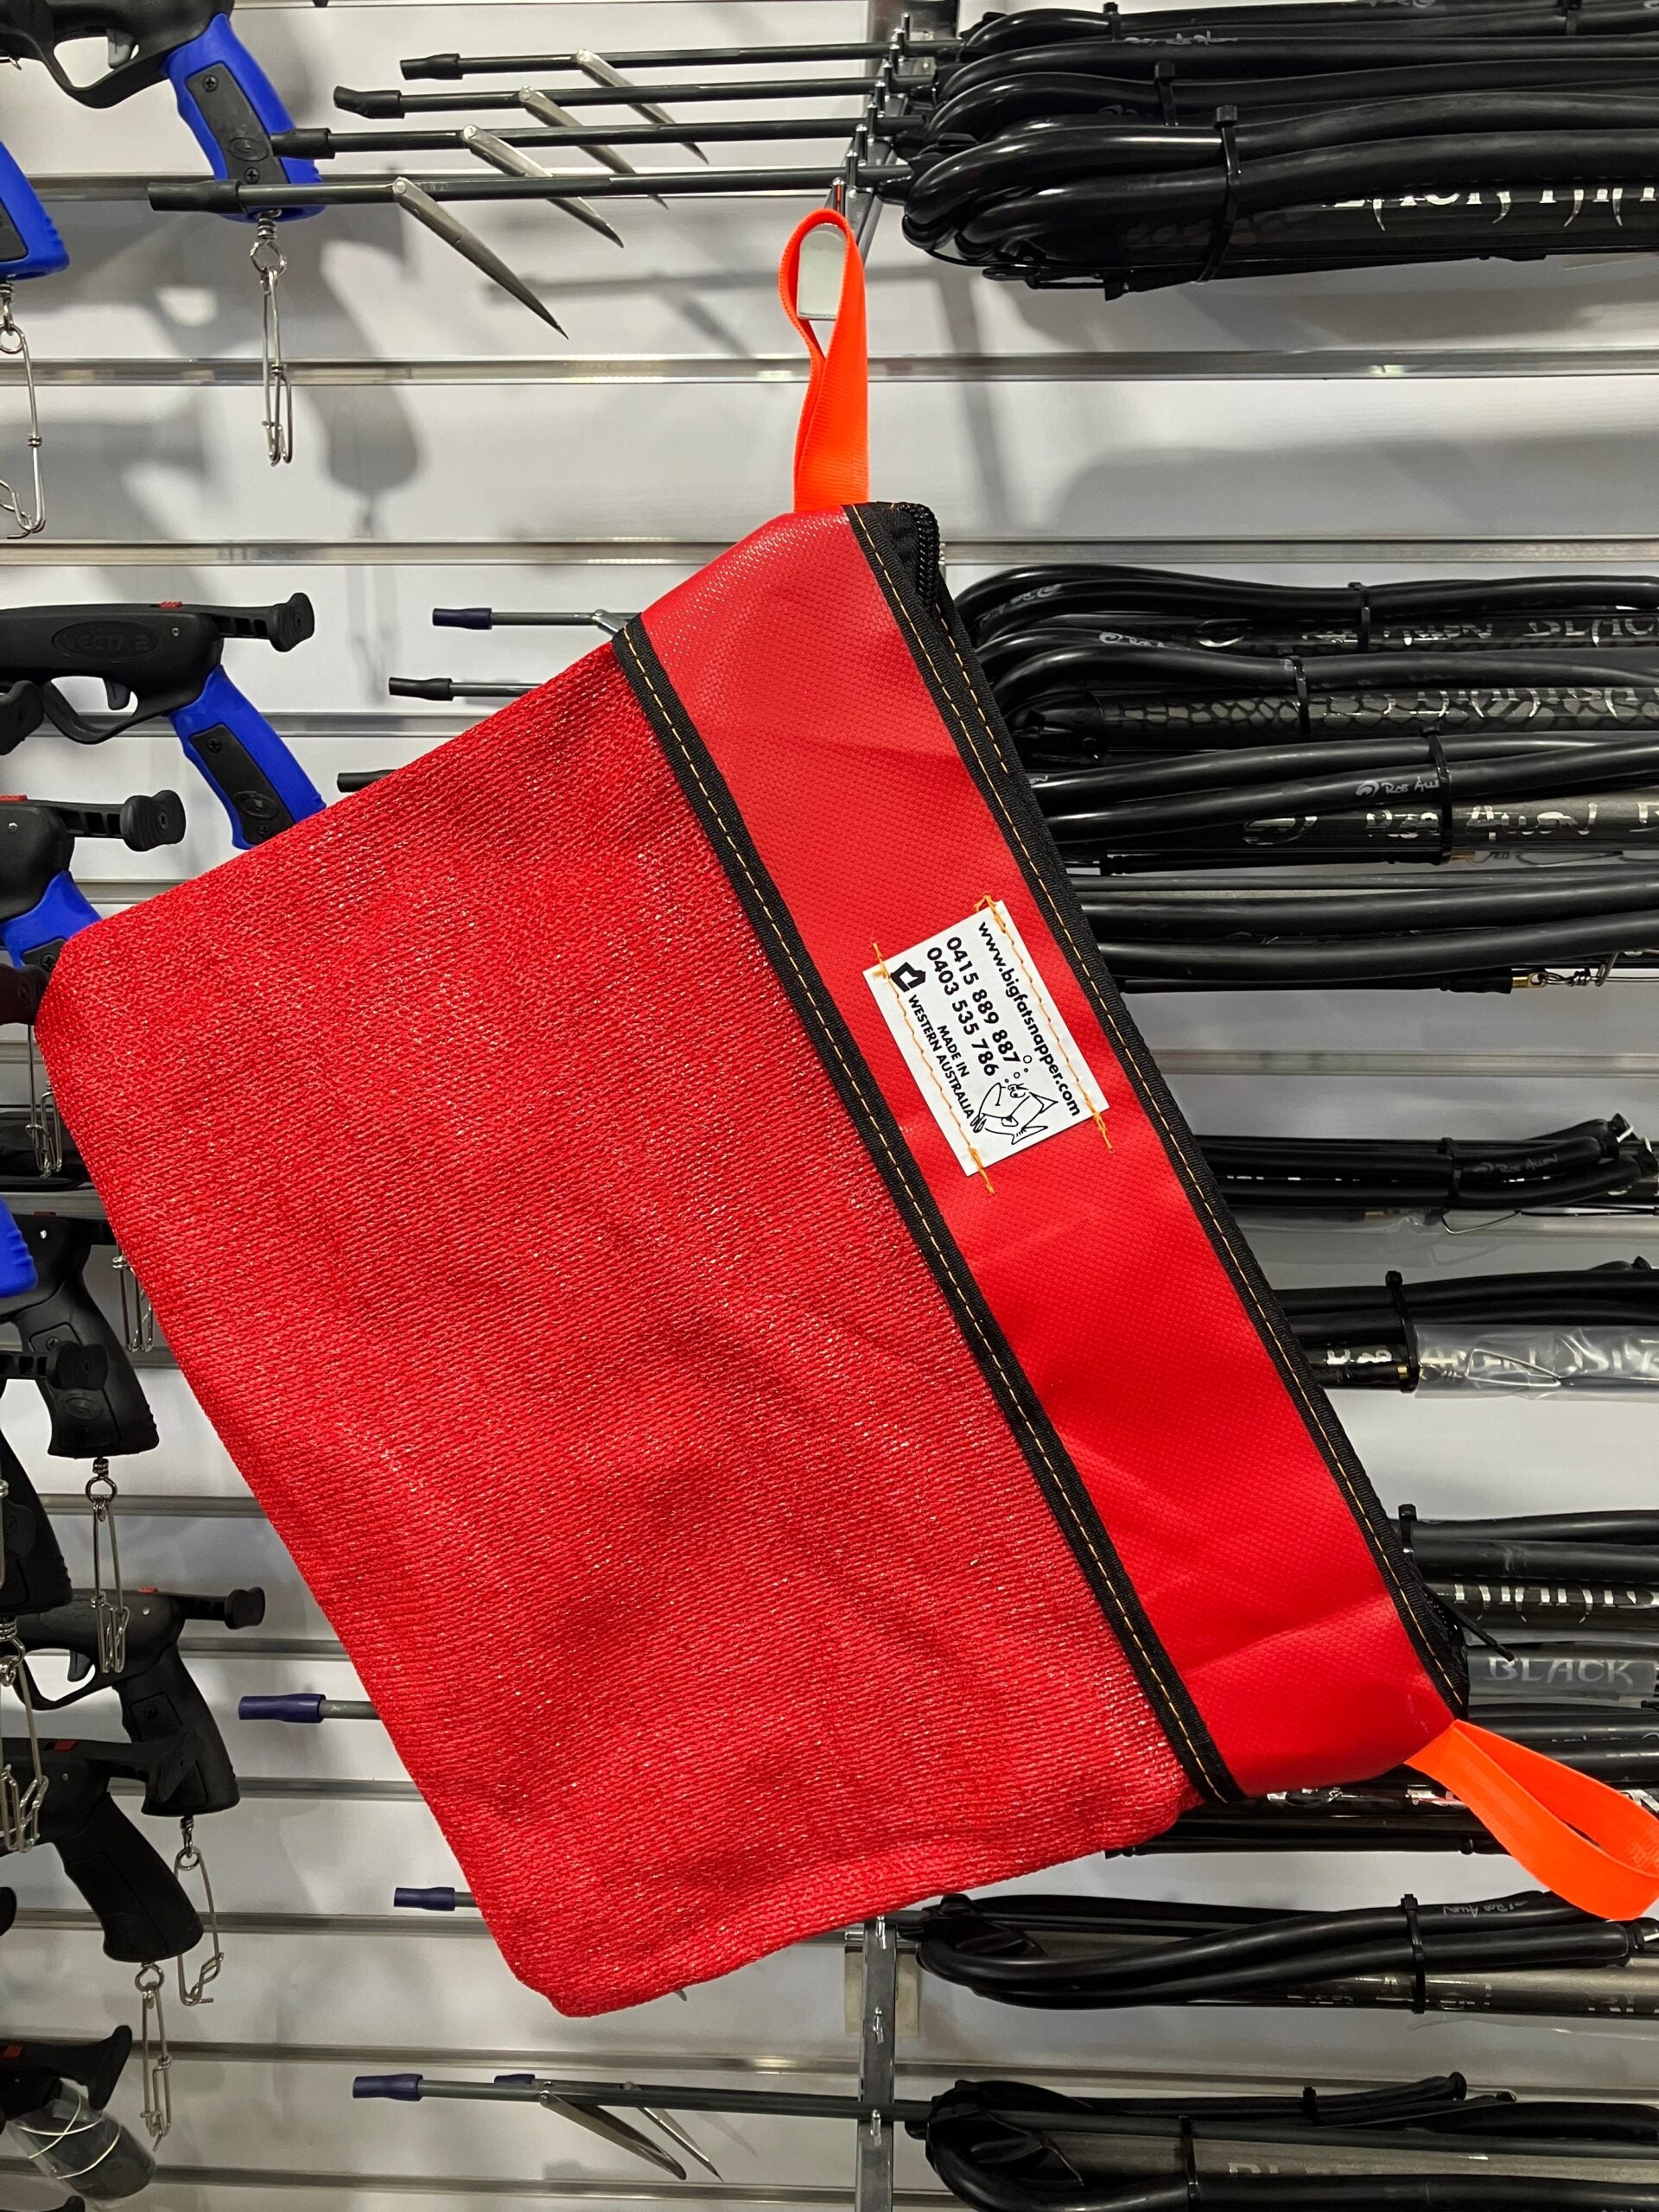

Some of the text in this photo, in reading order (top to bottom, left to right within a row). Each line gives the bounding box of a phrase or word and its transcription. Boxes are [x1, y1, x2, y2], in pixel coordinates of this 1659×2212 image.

[909, 995, 976, 1119] WESTERN AUSTRALIA
[927, 947, 999, 1077] 0403 535 786
[938, 1025, 969, 1077] MADE IN
[947, 937, 1020, 1063] 0415 889 887
[979, 922, 1080, 1116] www.bigfatsnapper.com
[1484, 1656, 1634, 1686] BLACK
